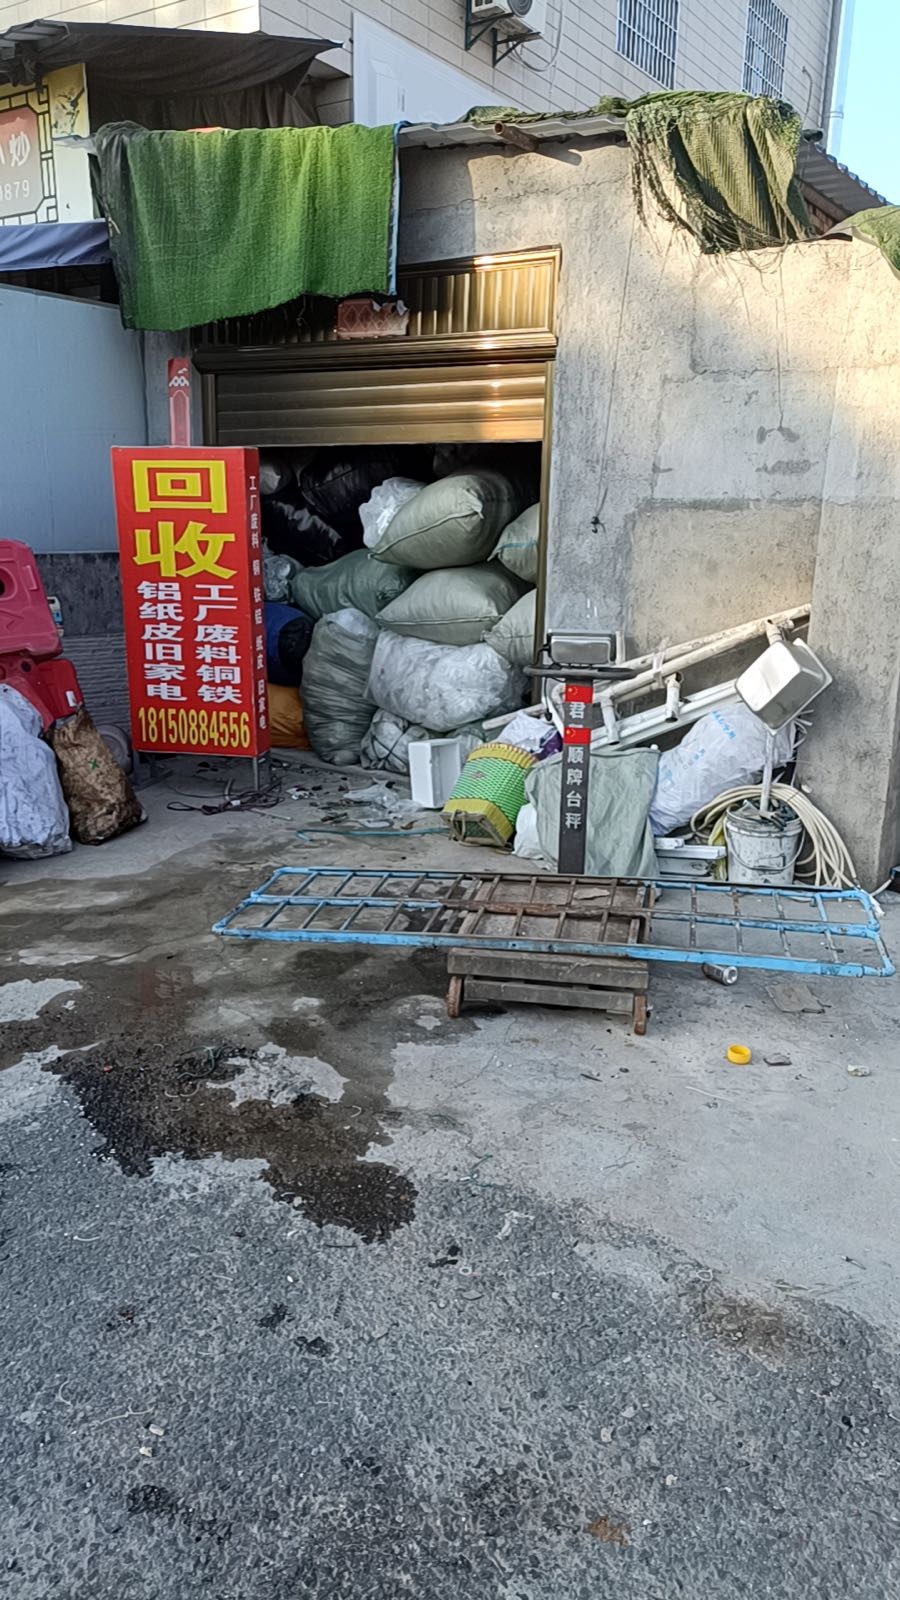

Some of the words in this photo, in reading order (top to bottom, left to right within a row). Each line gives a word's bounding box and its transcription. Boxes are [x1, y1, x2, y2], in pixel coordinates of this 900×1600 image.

[0, 179, 30, 201] 879
[132, 460, 238, 579] 回收
[137, 581, 188, 701] 铝纸皮旧家电
[193, 584, 243, 704] 工厂废料铜铁
[138, 706, 250, 749] 18150884556
[565, 702, 586, 830] 君顺牌台秤
